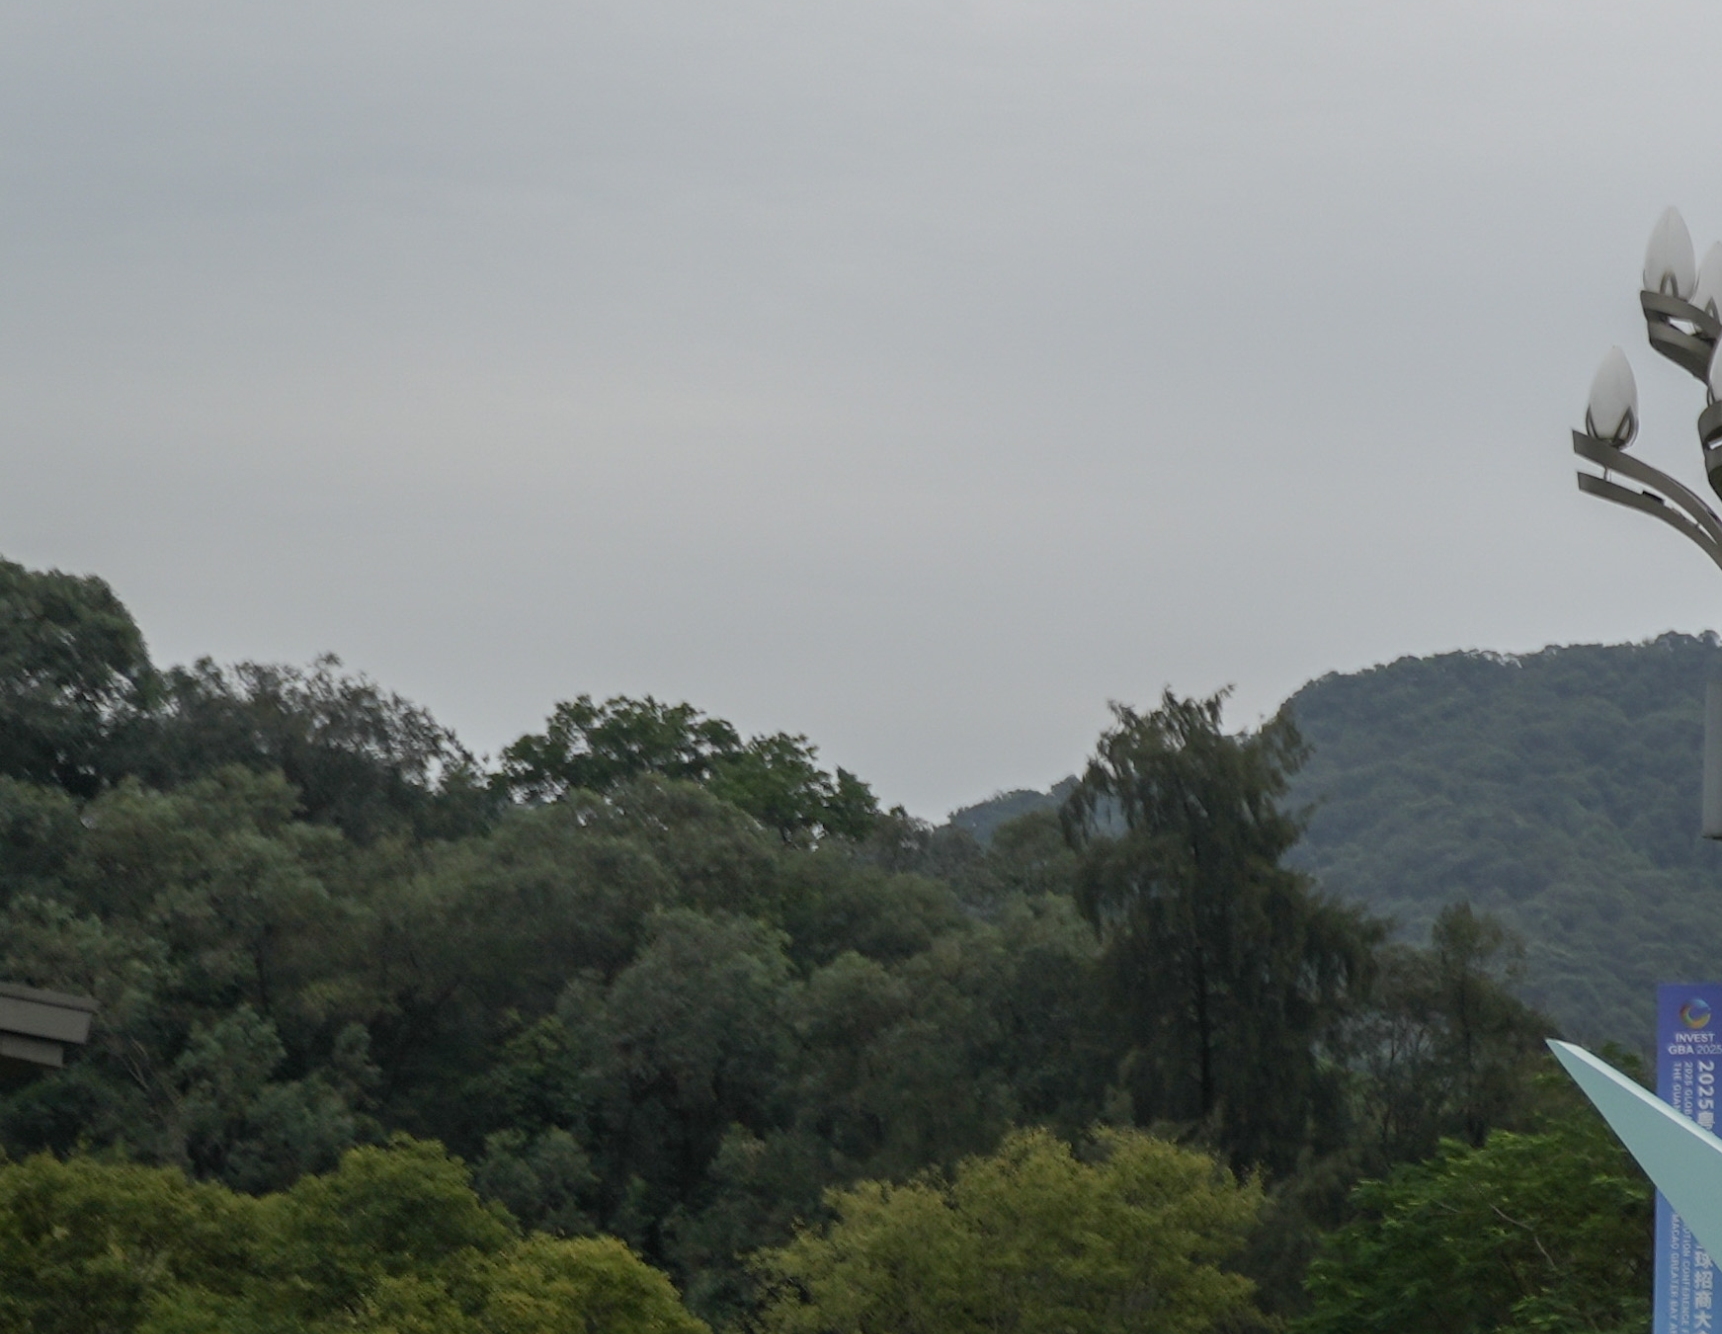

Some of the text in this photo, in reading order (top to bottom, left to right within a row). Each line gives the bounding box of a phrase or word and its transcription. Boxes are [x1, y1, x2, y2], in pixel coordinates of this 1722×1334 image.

[1675, 1033, 1716, 1043] INVEST
[1668, 1045, 1722, 1055] GBA 2025
